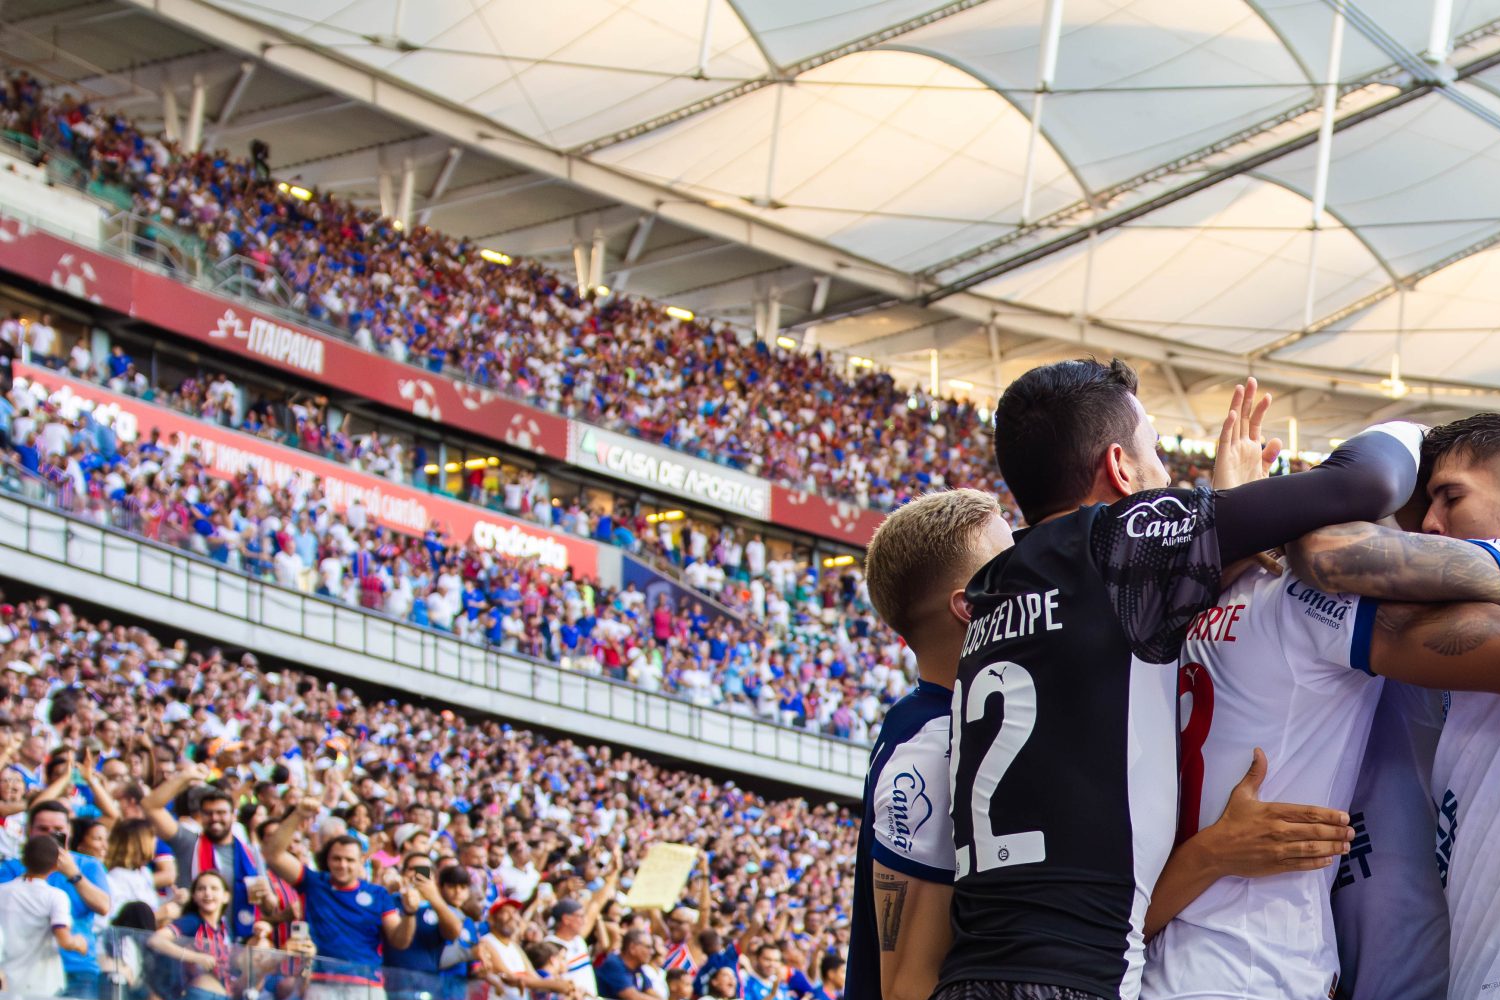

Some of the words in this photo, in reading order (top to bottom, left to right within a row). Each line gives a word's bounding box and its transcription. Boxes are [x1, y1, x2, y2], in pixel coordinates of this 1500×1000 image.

[247, 316, 325, 375] ITAIPAVA
[607, 446, 657, 483] CASA
[659, 460, 686, 488] DE
[684, 469, 764, 513] APOSTAS
[982, 588, 1063, 646] FELIPE
[1304, 607, 1341, 630] Alimentos
